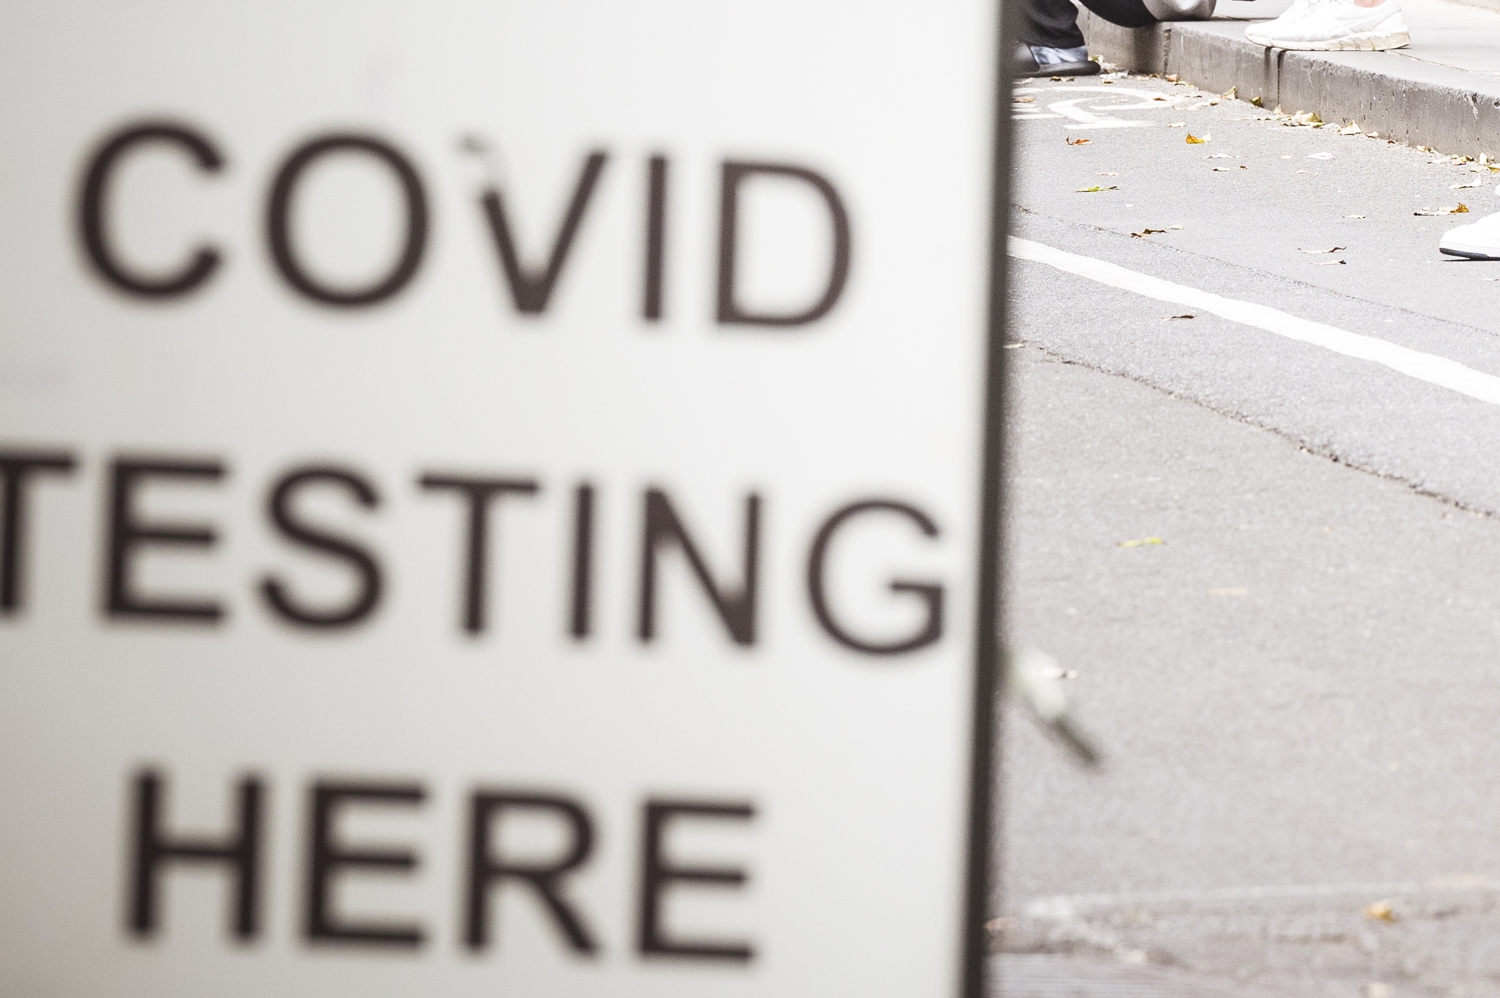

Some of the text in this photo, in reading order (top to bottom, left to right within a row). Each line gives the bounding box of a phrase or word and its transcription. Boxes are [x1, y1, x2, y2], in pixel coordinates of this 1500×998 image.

[72, 117, 851, 327] COVID
[0, 444, 945, 657] TESTING
[119, 765, 757, 965] HERE
